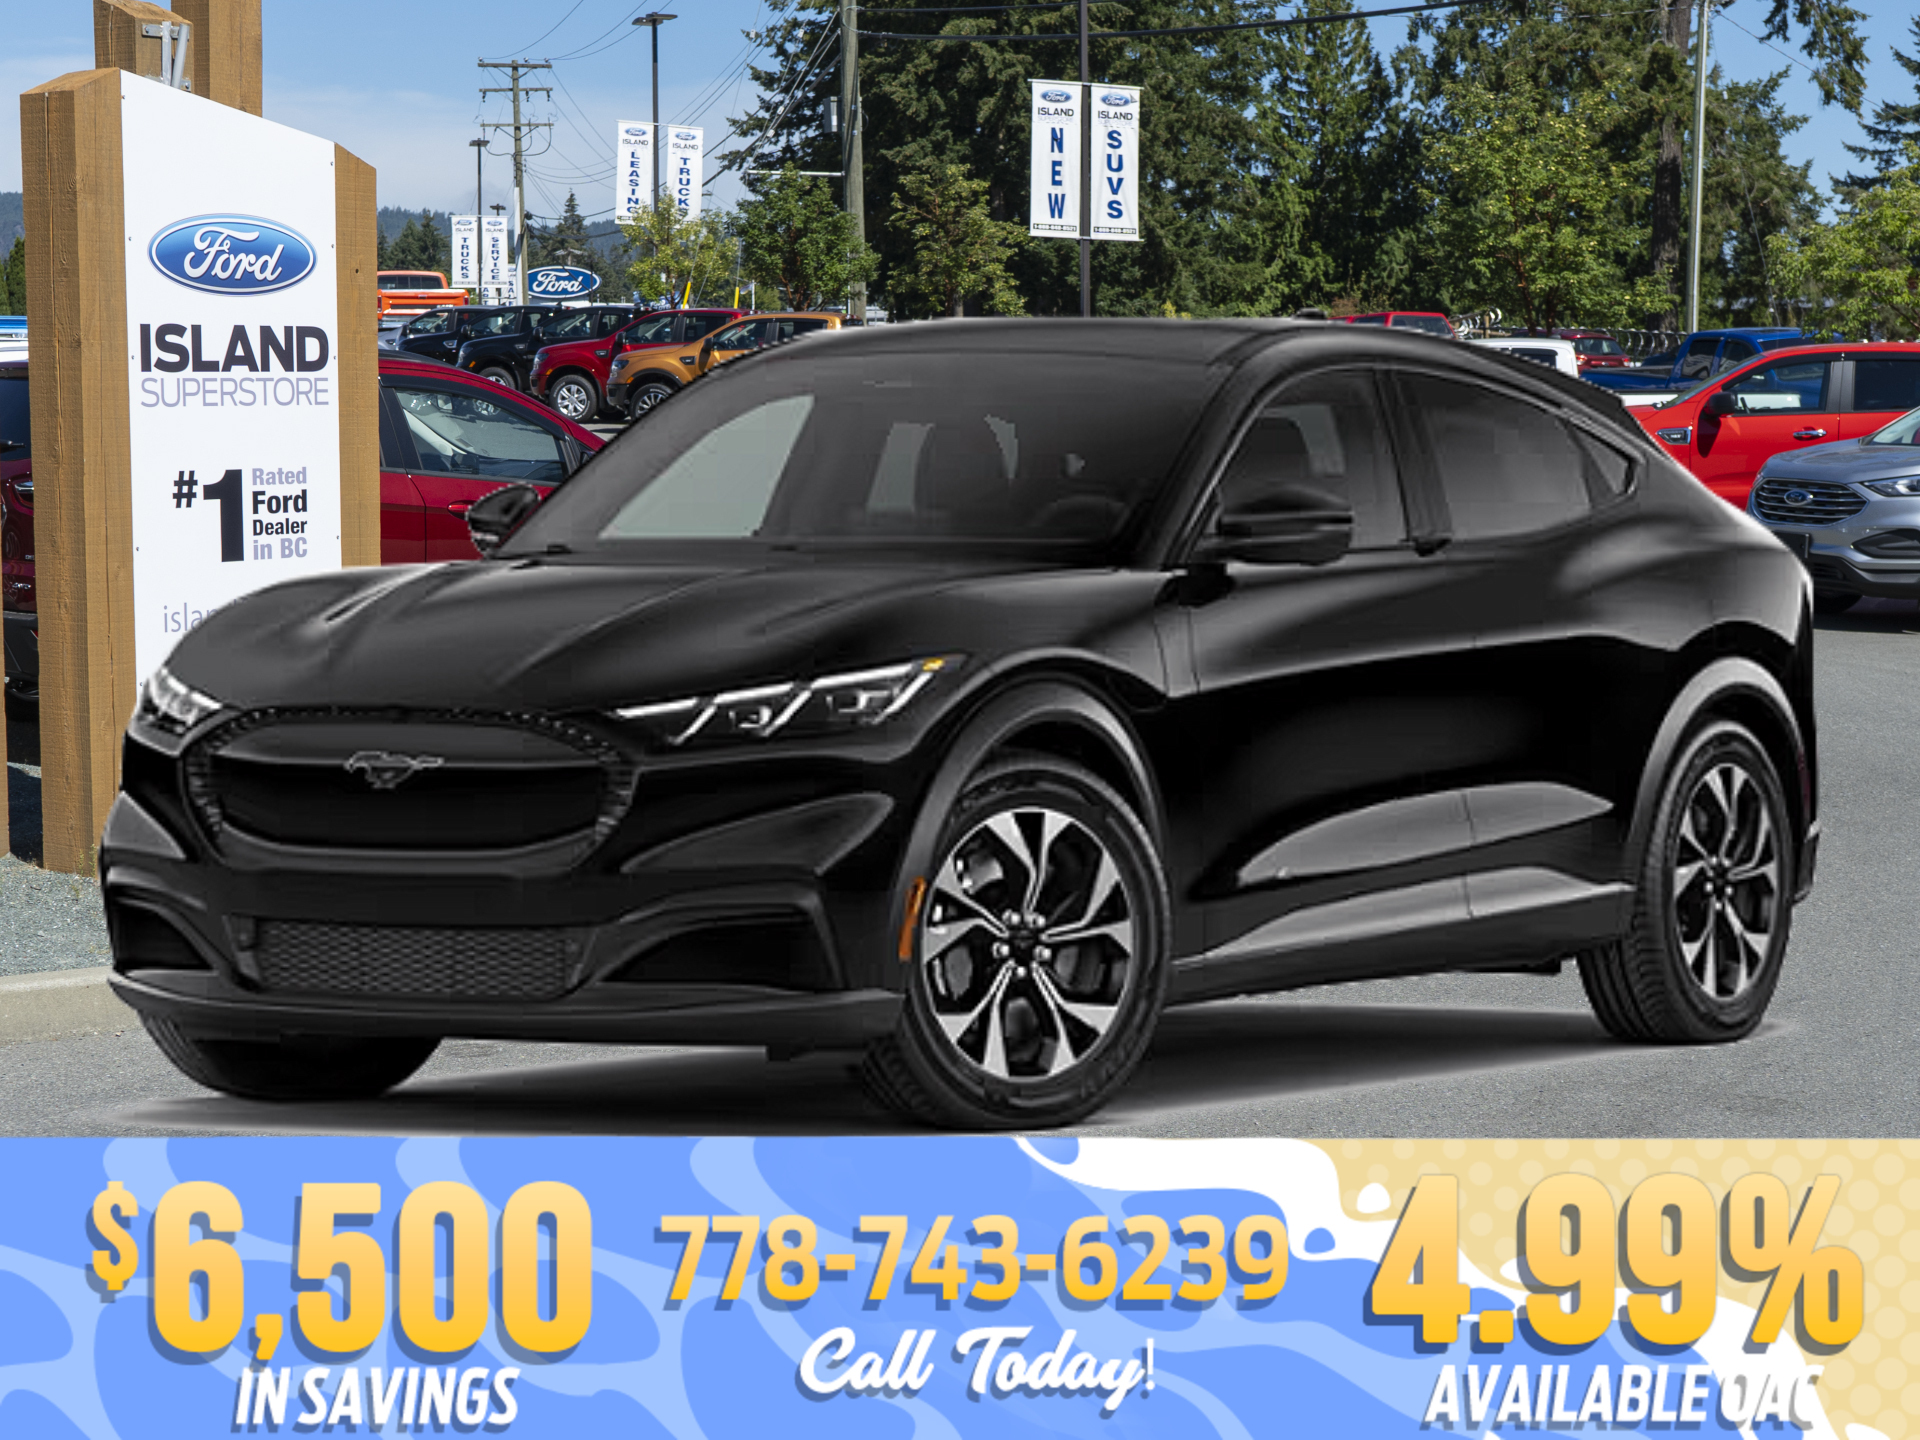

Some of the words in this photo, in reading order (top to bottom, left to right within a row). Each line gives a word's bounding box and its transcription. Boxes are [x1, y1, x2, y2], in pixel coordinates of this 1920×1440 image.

[1045, 89, 1067, 102] Ford
[1105, 92, 1127, 105] Ford
[1038, 107, 1074, 117] ISLAND
[1098, 111, 1133, 121] ISLAND
[1048, 127, 1066, 219] NEW
[1106, 130, 1124, 219] SUVS
[184, 226, 284, 281] Ford
[461, 237, 469, 279] TRUCKS
[490, 237, 500, 280] SERVICE
[532, 270, 584, 292] Ford
[139, 323, 329, 373] ISLAND
[140, 377, 329, 407] SUPERSTORE
[252, 467, 307, 486] Rated
[252, 489, 308, 514] Ford
[172, 469, 244, 562] #1
[252, 518, 307, 536] Dealer
[253, 539, 273, 560] in
[280, 537, 308, 558] BC
